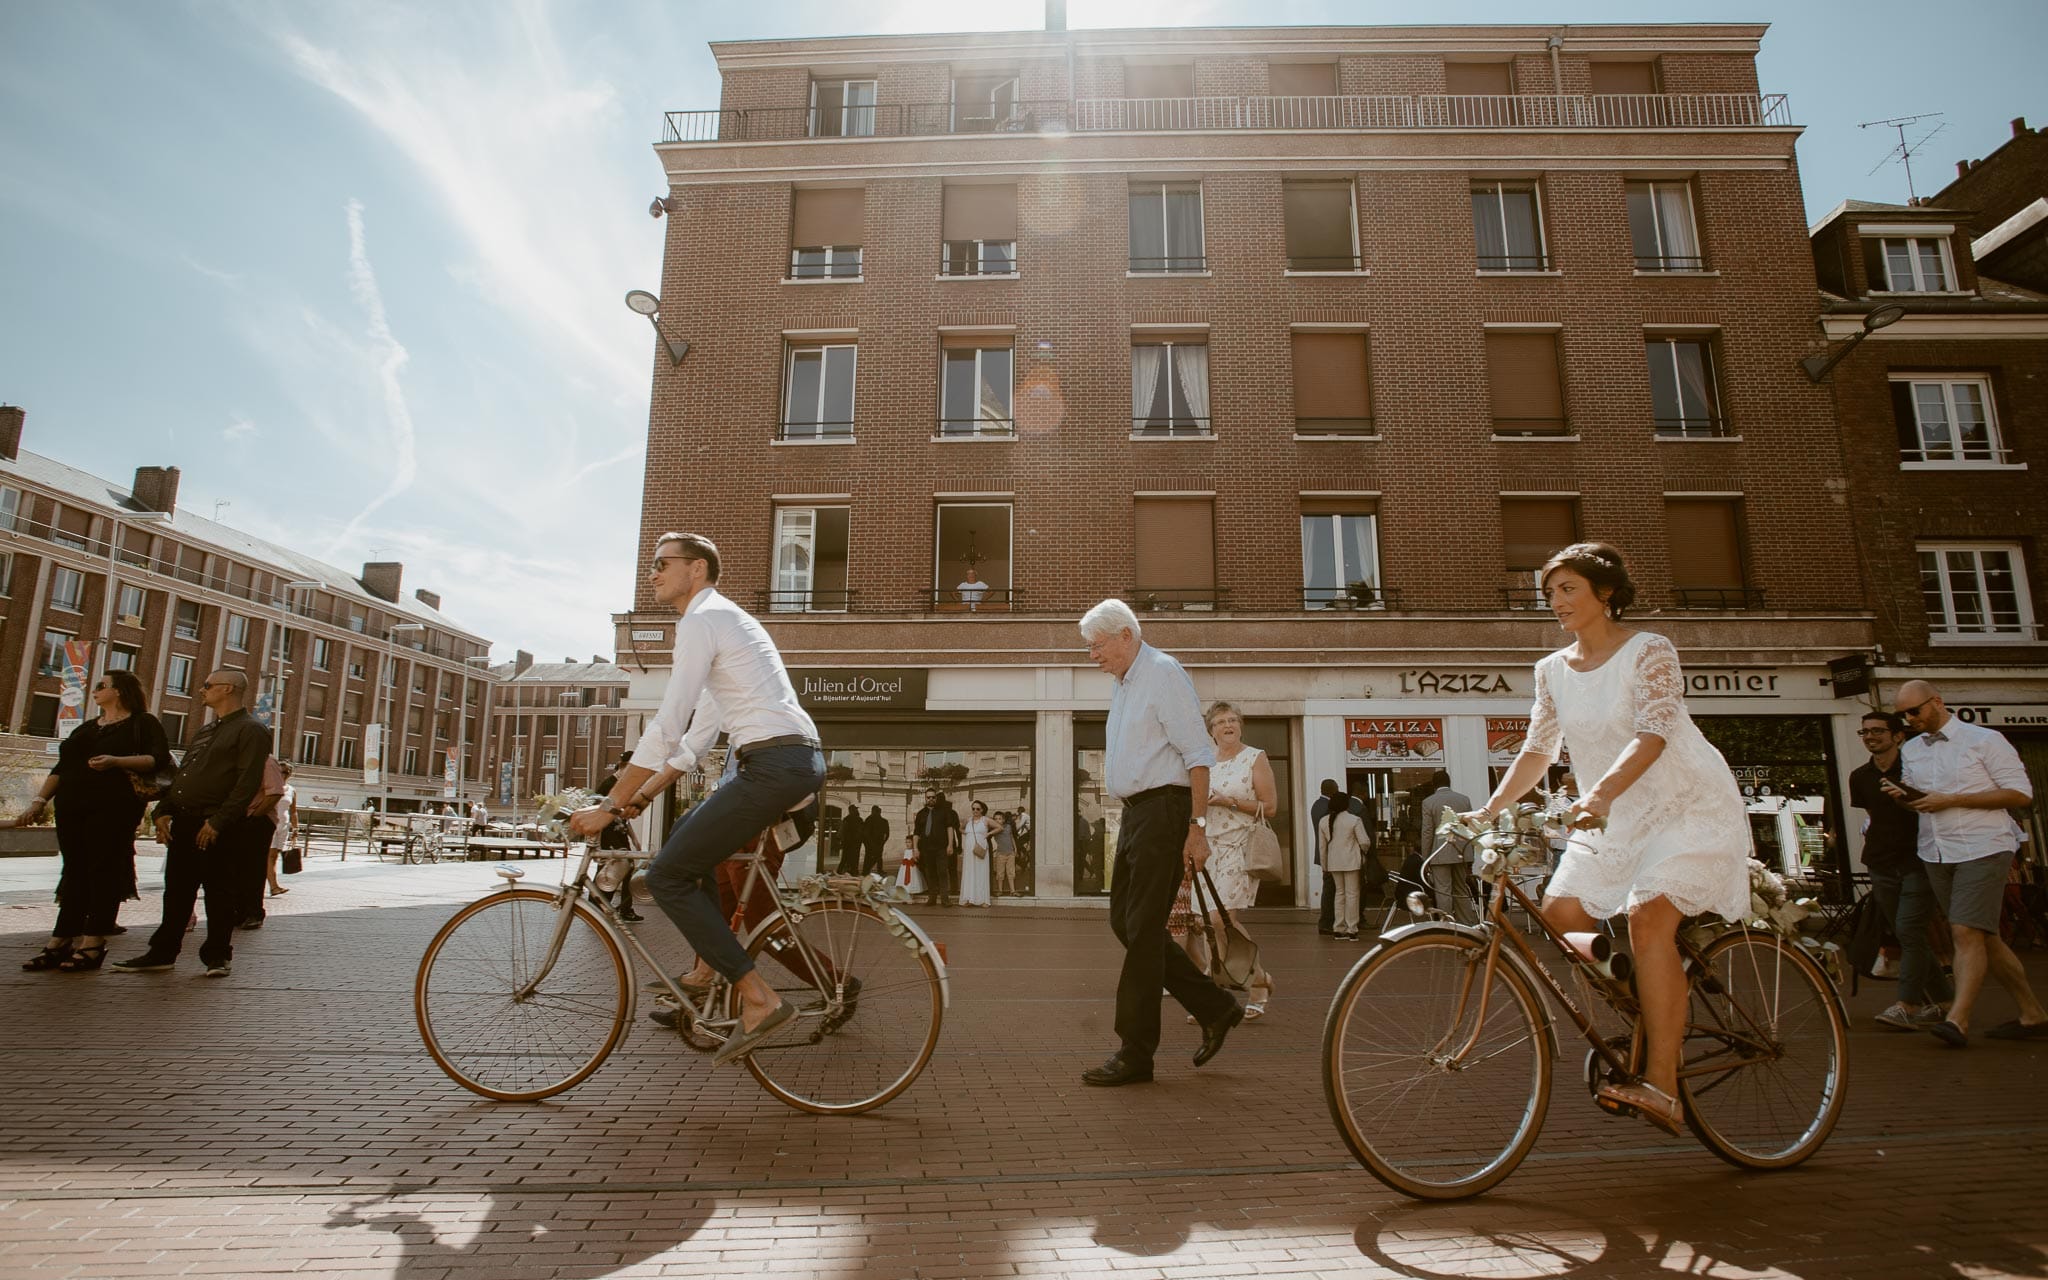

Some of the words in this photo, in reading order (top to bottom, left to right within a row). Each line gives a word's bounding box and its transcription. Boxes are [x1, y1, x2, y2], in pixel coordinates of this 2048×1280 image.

[800, 677, 844, 695] Julien
[1398, 670, 1512, 693] L'AZIZA
[1351, 720, 1436, 732] L'AZIZA
[1487, 720, 1528, 731] L'AZIZ
